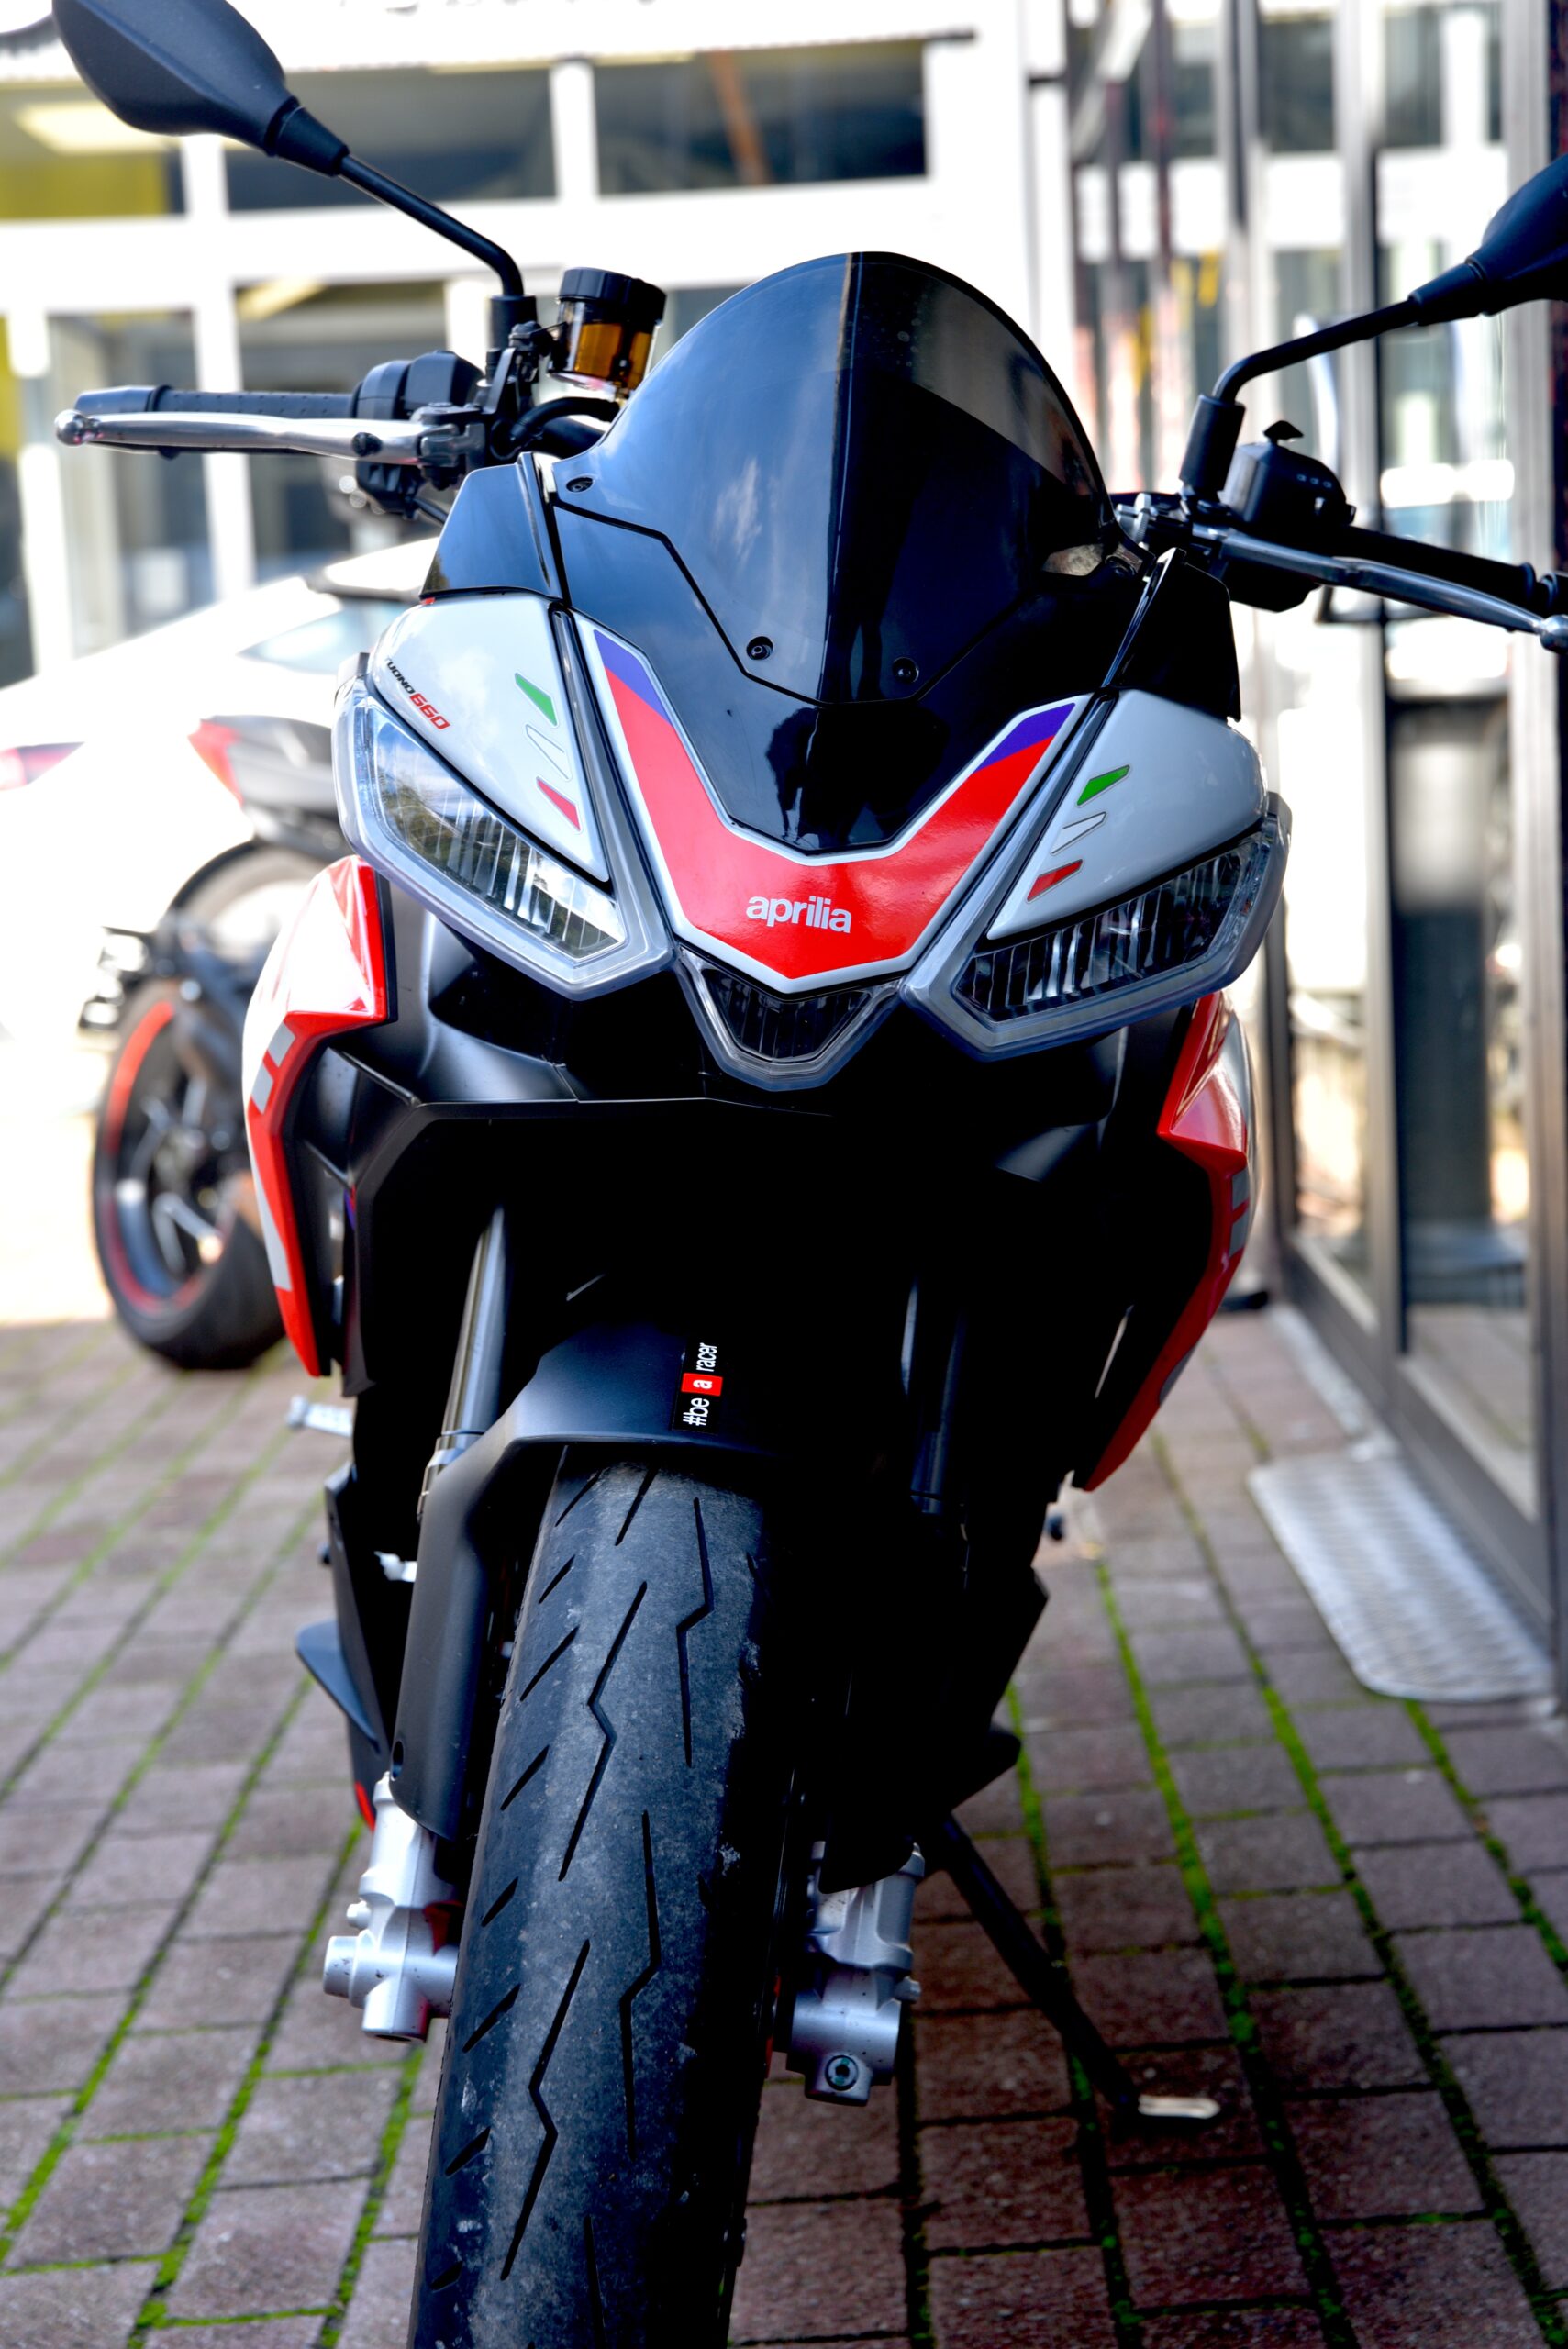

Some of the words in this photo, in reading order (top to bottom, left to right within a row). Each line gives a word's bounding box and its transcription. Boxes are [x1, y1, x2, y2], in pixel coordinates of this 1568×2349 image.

[409, 693, 450, 729] 660
[746, 896, 852, 933] aprilia
[696, 1342, 717, 1372] racer
[693, 1379, 713, 1389] a
[683, 1397, 710, 1426] #be
